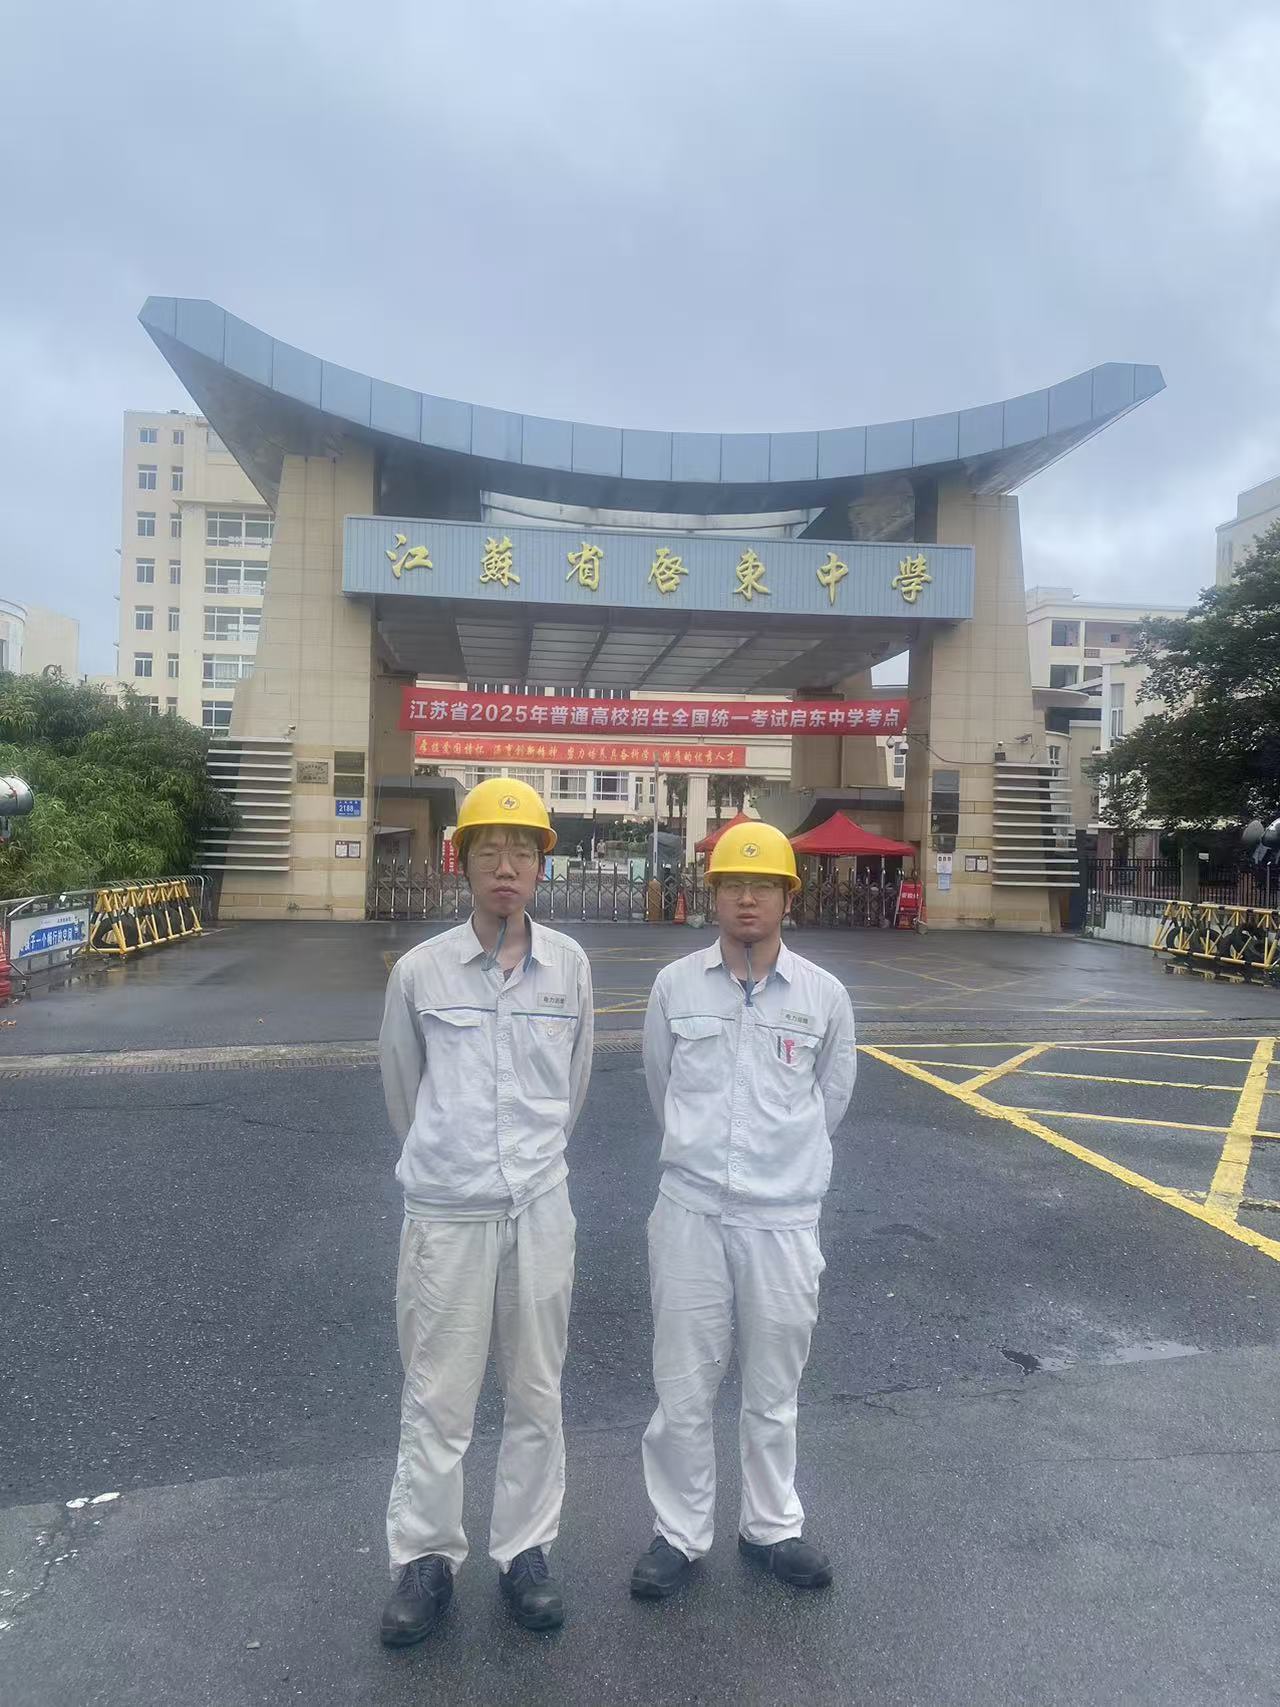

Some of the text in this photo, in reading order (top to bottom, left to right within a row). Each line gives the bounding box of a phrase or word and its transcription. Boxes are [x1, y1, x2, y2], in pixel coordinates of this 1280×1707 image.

[409, 699, 901, 728] 江苏省2025年普通高校招生全国统一考试启东中学考点
